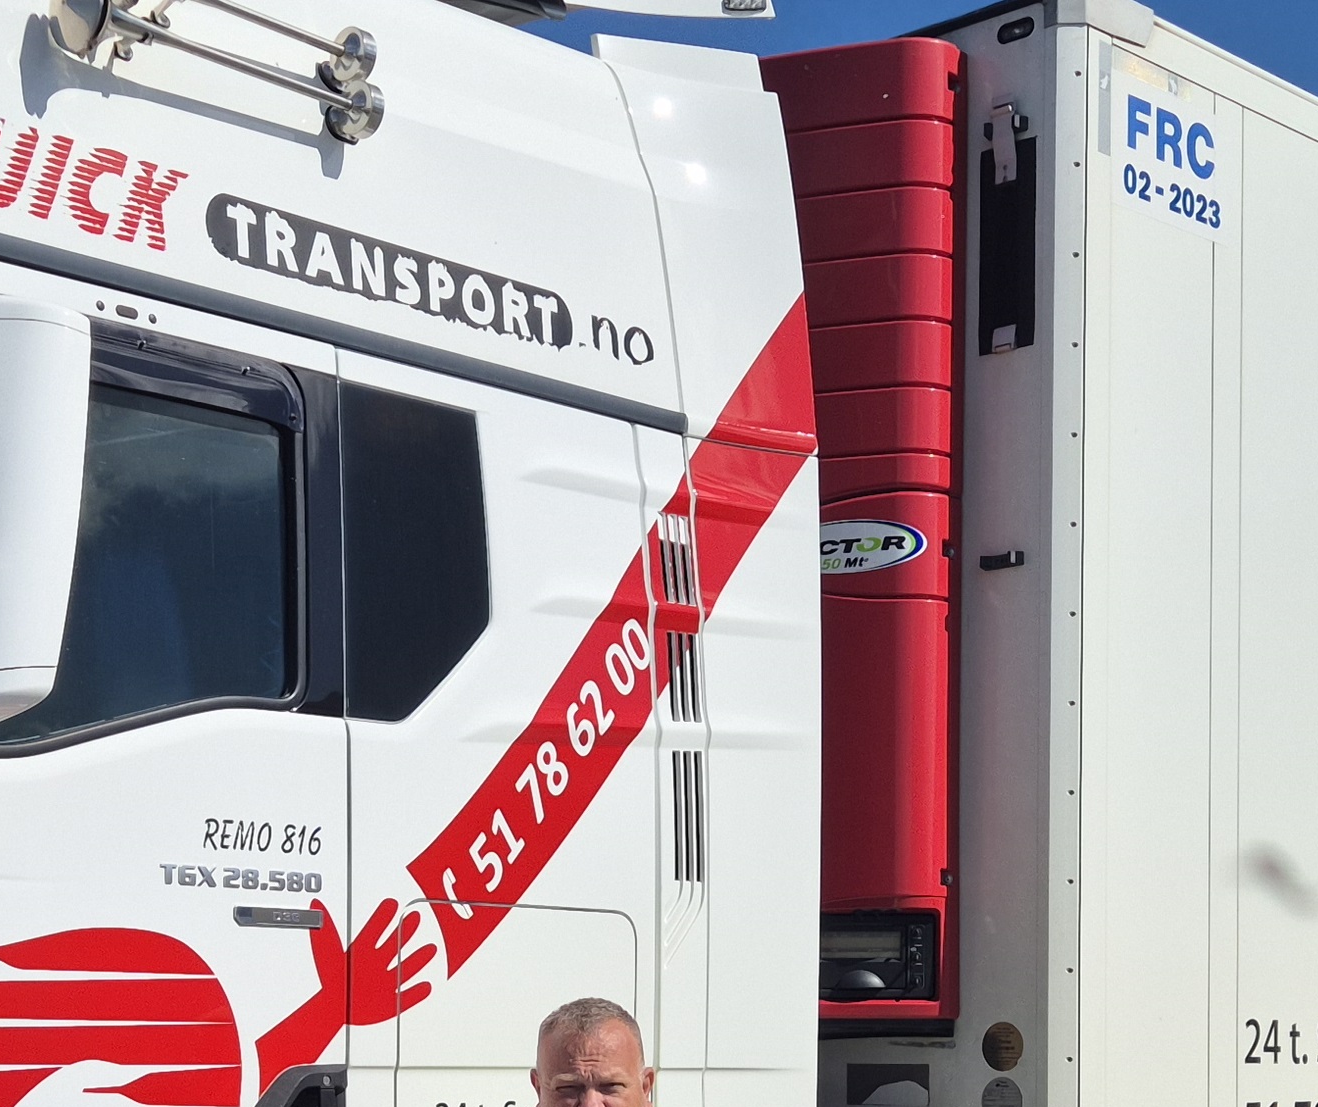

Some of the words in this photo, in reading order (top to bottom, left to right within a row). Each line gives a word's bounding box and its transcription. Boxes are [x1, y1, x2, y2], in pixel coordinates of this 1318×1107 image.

[1126, 93, 1216, 180] FRC
[225, 201, 560, 345] TRANSPORT
[468, 806, 526, 894] 51
[514, 740, 570, 825] 78
[566, 679, 616, 757] 62
[604, 617, 652, 696] 00
[202, 817, 273, 852] REMO
[280, 824, 323, 856] 816
[159, 863, 218, 888] TGX
[222, 867, 323, 894] 28.580
[1243, 1018, 1282, 1065] 24
[1289, 1022, 1309, 1065] t.
